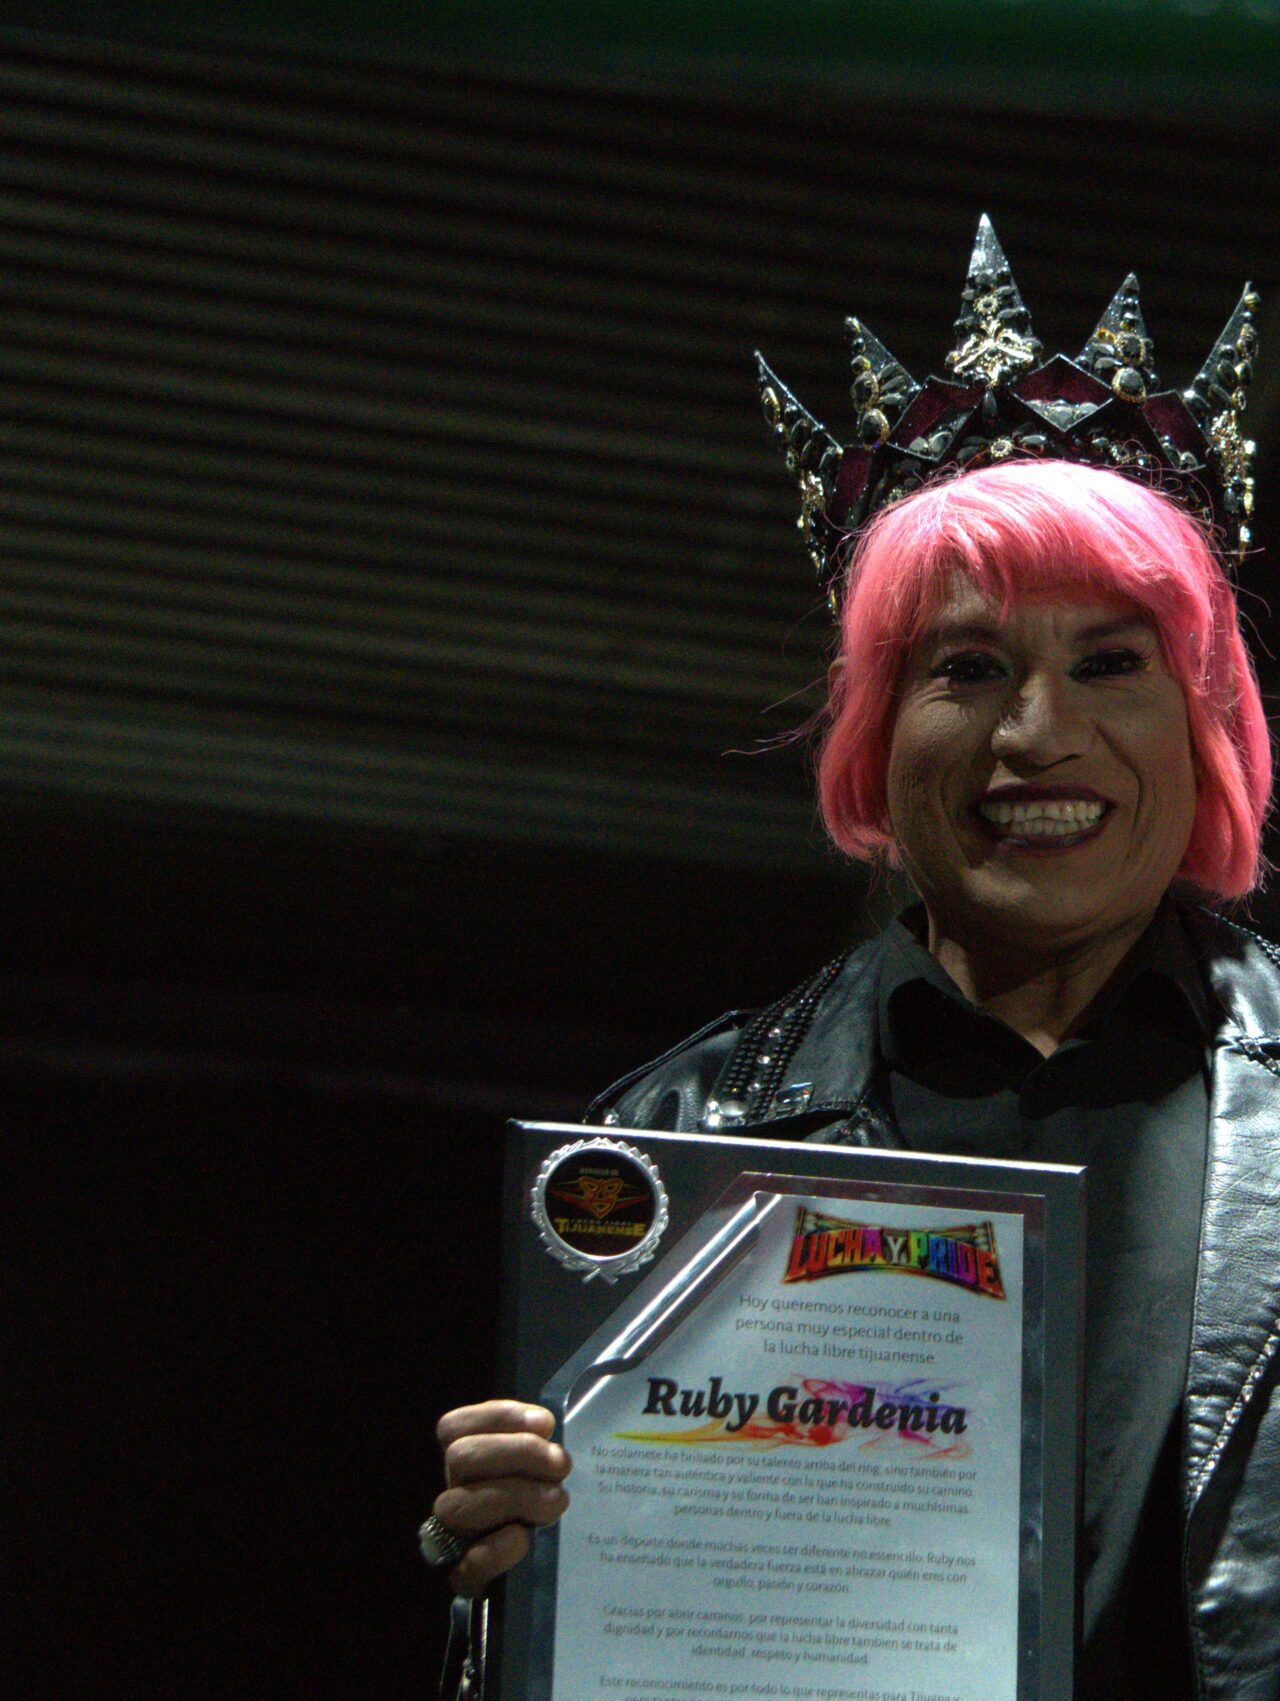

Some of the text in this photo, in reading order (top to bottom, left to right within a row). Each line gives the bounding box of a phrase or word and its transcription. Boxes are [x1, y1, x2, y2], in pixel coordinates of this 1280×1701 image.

[784, 1227, 1004, 1299] LUCHA Y PRIDE
[739, 1293, 960, 1322] Hoy queremos reconocer a una
[735, 1317, 963, 1344] persona muy especial dentro de
[763, 1339, 776, 1353] la
[780, 1340, 819, 1356] lucha
[823, 1343, 855, 1358] libre
[642, 1376, 968, 1434] Ruby Gardenia
[592, 1445, 608, 1456] No
[665, 1448, 678, 1460] ha
[681, 1449, 724, 1463] brillado
[727, 1456, 744, 1467] por
[747, 1457, 759, 1465] su
[762, 1455, 801, 1468] talento
[804, 1458, 835, 1470] arriba
[839, 1459, 855, 1471] del
[885, 1463, 908, 1475] sino
[910, 1465, 956, 1478] también
[959, 1470, 976, 1481] por
[596, 1462, 605, 1474] la
[608, 1466, 650, 1476] manera
[653, 1468, 671, 1478] tan
[728, 1474, 734, 1485] y
[738, 1471, 779, 1484] valiente
[782, 1477, 802, 1486] con
[805, 1475, 814, 1486] la
[817, 1479, 837, 1490] que
[840, 1477, 853, 1489] ha
[856, 1480, 915, 1492] construido
[917, 1485, 929, 1493] su
[598, 1481, 612, 1492] Su
[662, 1487, 675, 1496] su
[678, 1487, 721, 1499] carisma
[722, 1491, 728, 1502] y
[731, 1492, 744, 1500] su
[747, 1489, 779, 1502] forma
[782, 1491, 796, 1503] de
[798, 1496, 814, 1504] ser
[817, 1493, 837, 1505] han
[840, 1495, 892, 1510] inspirado
[894, 1501, 899, 1509] a
[674, 1504, 724, 1516] personas
[727, 1504, 763, 1517] dentro
[765, 1510, 772, 1521] y
[775, 1507, 802, 1520] fuera
[806, 1509, 819, 1521] de
[822, 1510, 831, 1522] la
[834, 1511, 863, 1523] lucha
[588, 1533, 600, 1544] Es
[603, 1536, 616, 1545] un
[621, 1534, 664, 1549] deporte
[666, 1536, 701, 1550] donde
[704, 1540, 748, 1552] muchas
[751, 1545, 780, 1554] veces
[782, 1547, 798, 1555] ser
[801, 1544, 850, 1558] diferente
[853, 1551, 866, 1559] no
[927, 1552, 954, 1568] Ruby
[956, 1557, 976, 1566] nos
[600, 1549, 613, 1561] ha
[673, 1557, 694, 1568] que
[697, 1555, 706, 1567] la
[711, 1557, 763, 1570] verdadera
[767, 1559, 801, 1572] fuerza
[830, 1566, 843, 1574] en
[846, 1564, 886, 1577] abrazar
[922, 1571, 944, 1580] eres
[947, 1573, 967, 1582] con
[796, 1582, 803, 1593] y
[646, 1609, 665, 1620] por
[669, 1607, 694, 1619] abrir
[749, 1614, 767, 1626] por
[770, 1616, 833, 1628] representar
[836, 1616, 845, 1627] la
[848, 1616, 904, 1631] diversidad
[907, 1623, 927, 1632] con
[929, 1623, 958, 1634] tanta
[604, 1620, 654, 1636] dignidad
[657, 1627, 663, 1638] y
[666, 1627, 684, 1639] por
[756, 1632, 776, 1643] que
[779, 1630, 788, 1642] la
[792, 1631, 821, 1643] lucha
[825, 1632, 850, 1645] libre
[901, 1640, 912, 1648] se
[915, 1639, 940, 1650] trata
[944, 1639, 956, 1651] de
[751, 1649, 792, 1662] respeto
[794, 1652, 801, 1663] y
[600, 1676, 622, 1687] Este
[626, 1679, 713, 1692] reconocimiento
[716, 1684, 727, 1693] es
[730, 1685, 749, 1696] por
[752, 1683, 777, 1695] todo
[781, 1684, 791, 1696] lo
[793, 1688, 814, 1700] que
[816, 1690, 880, 1701] representas
[882, 1693, 906, 1701] para
